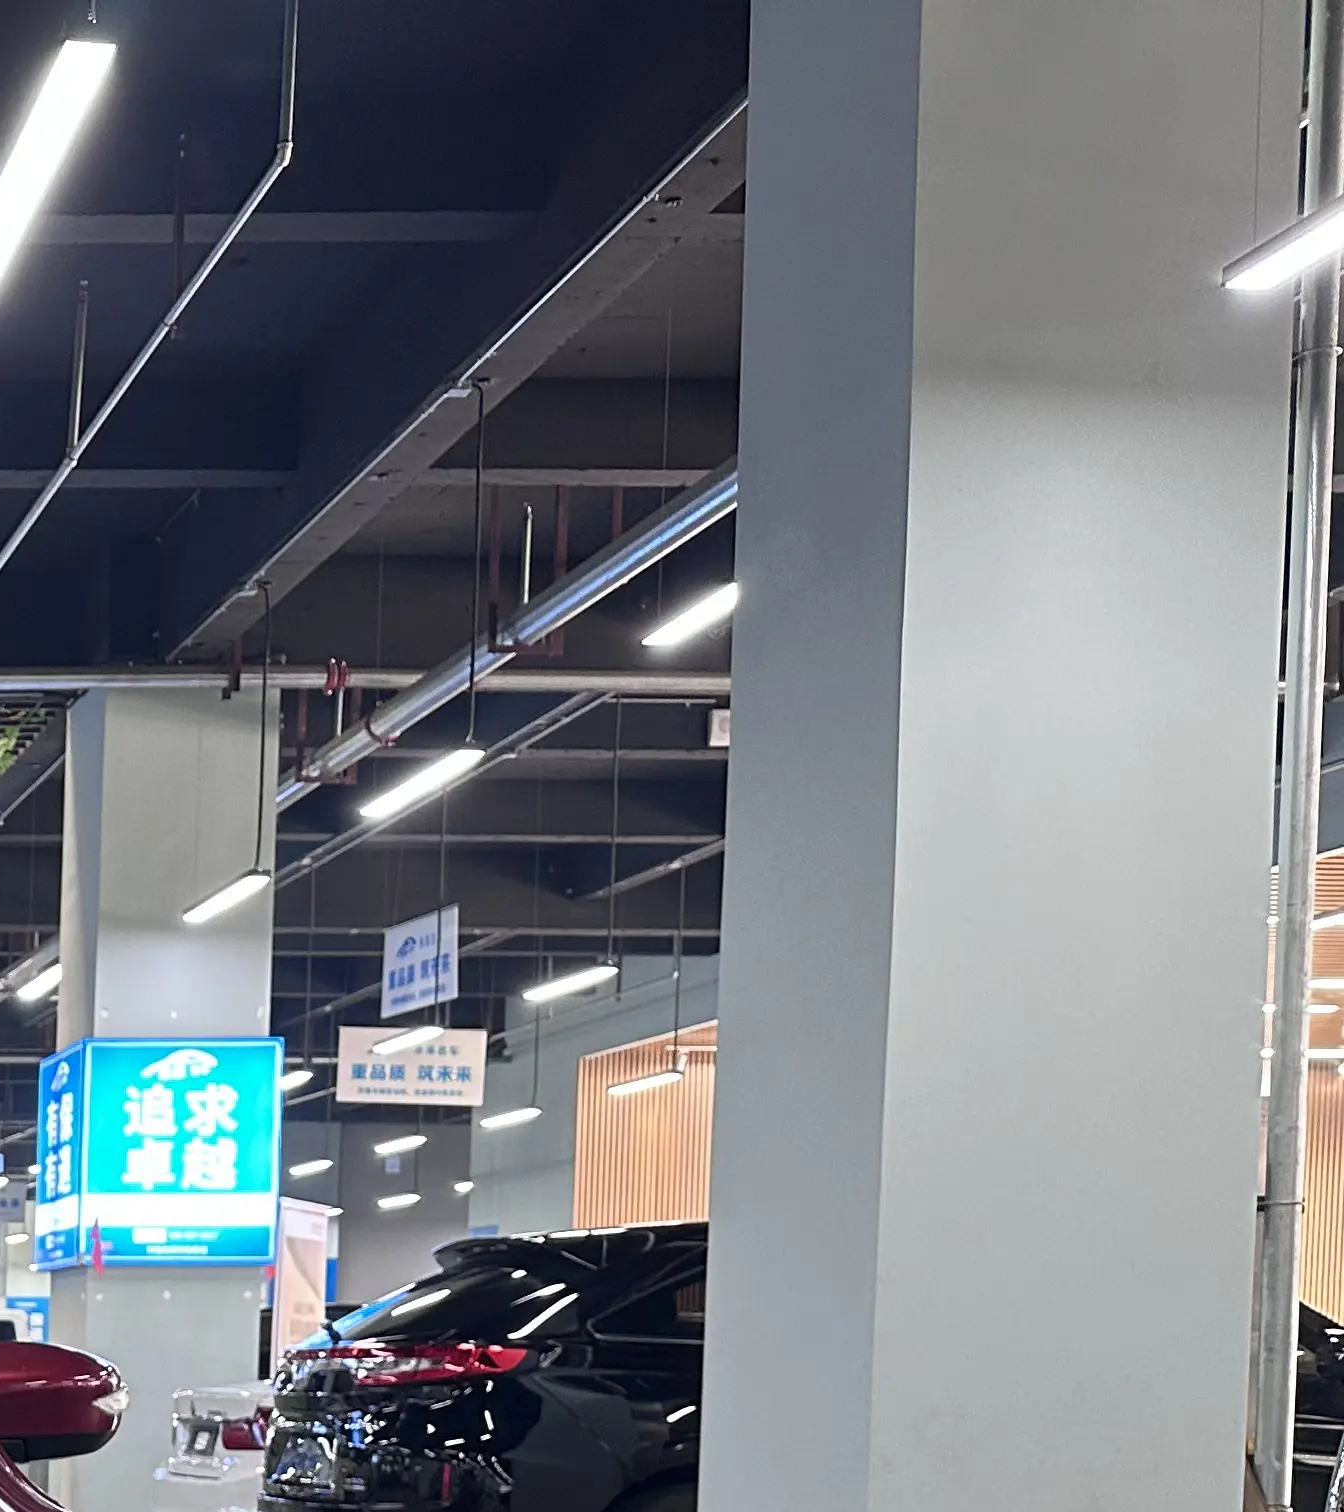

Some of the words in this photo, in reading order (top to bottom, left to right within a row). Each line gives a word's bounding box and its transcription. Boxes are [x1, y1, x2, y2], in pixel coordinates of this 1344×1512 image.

[350, 1063, 406, 1081] 重品质
[417, 1065, 473, 1084] 筑未来
[122, 1082, 240, 1137] 追求
